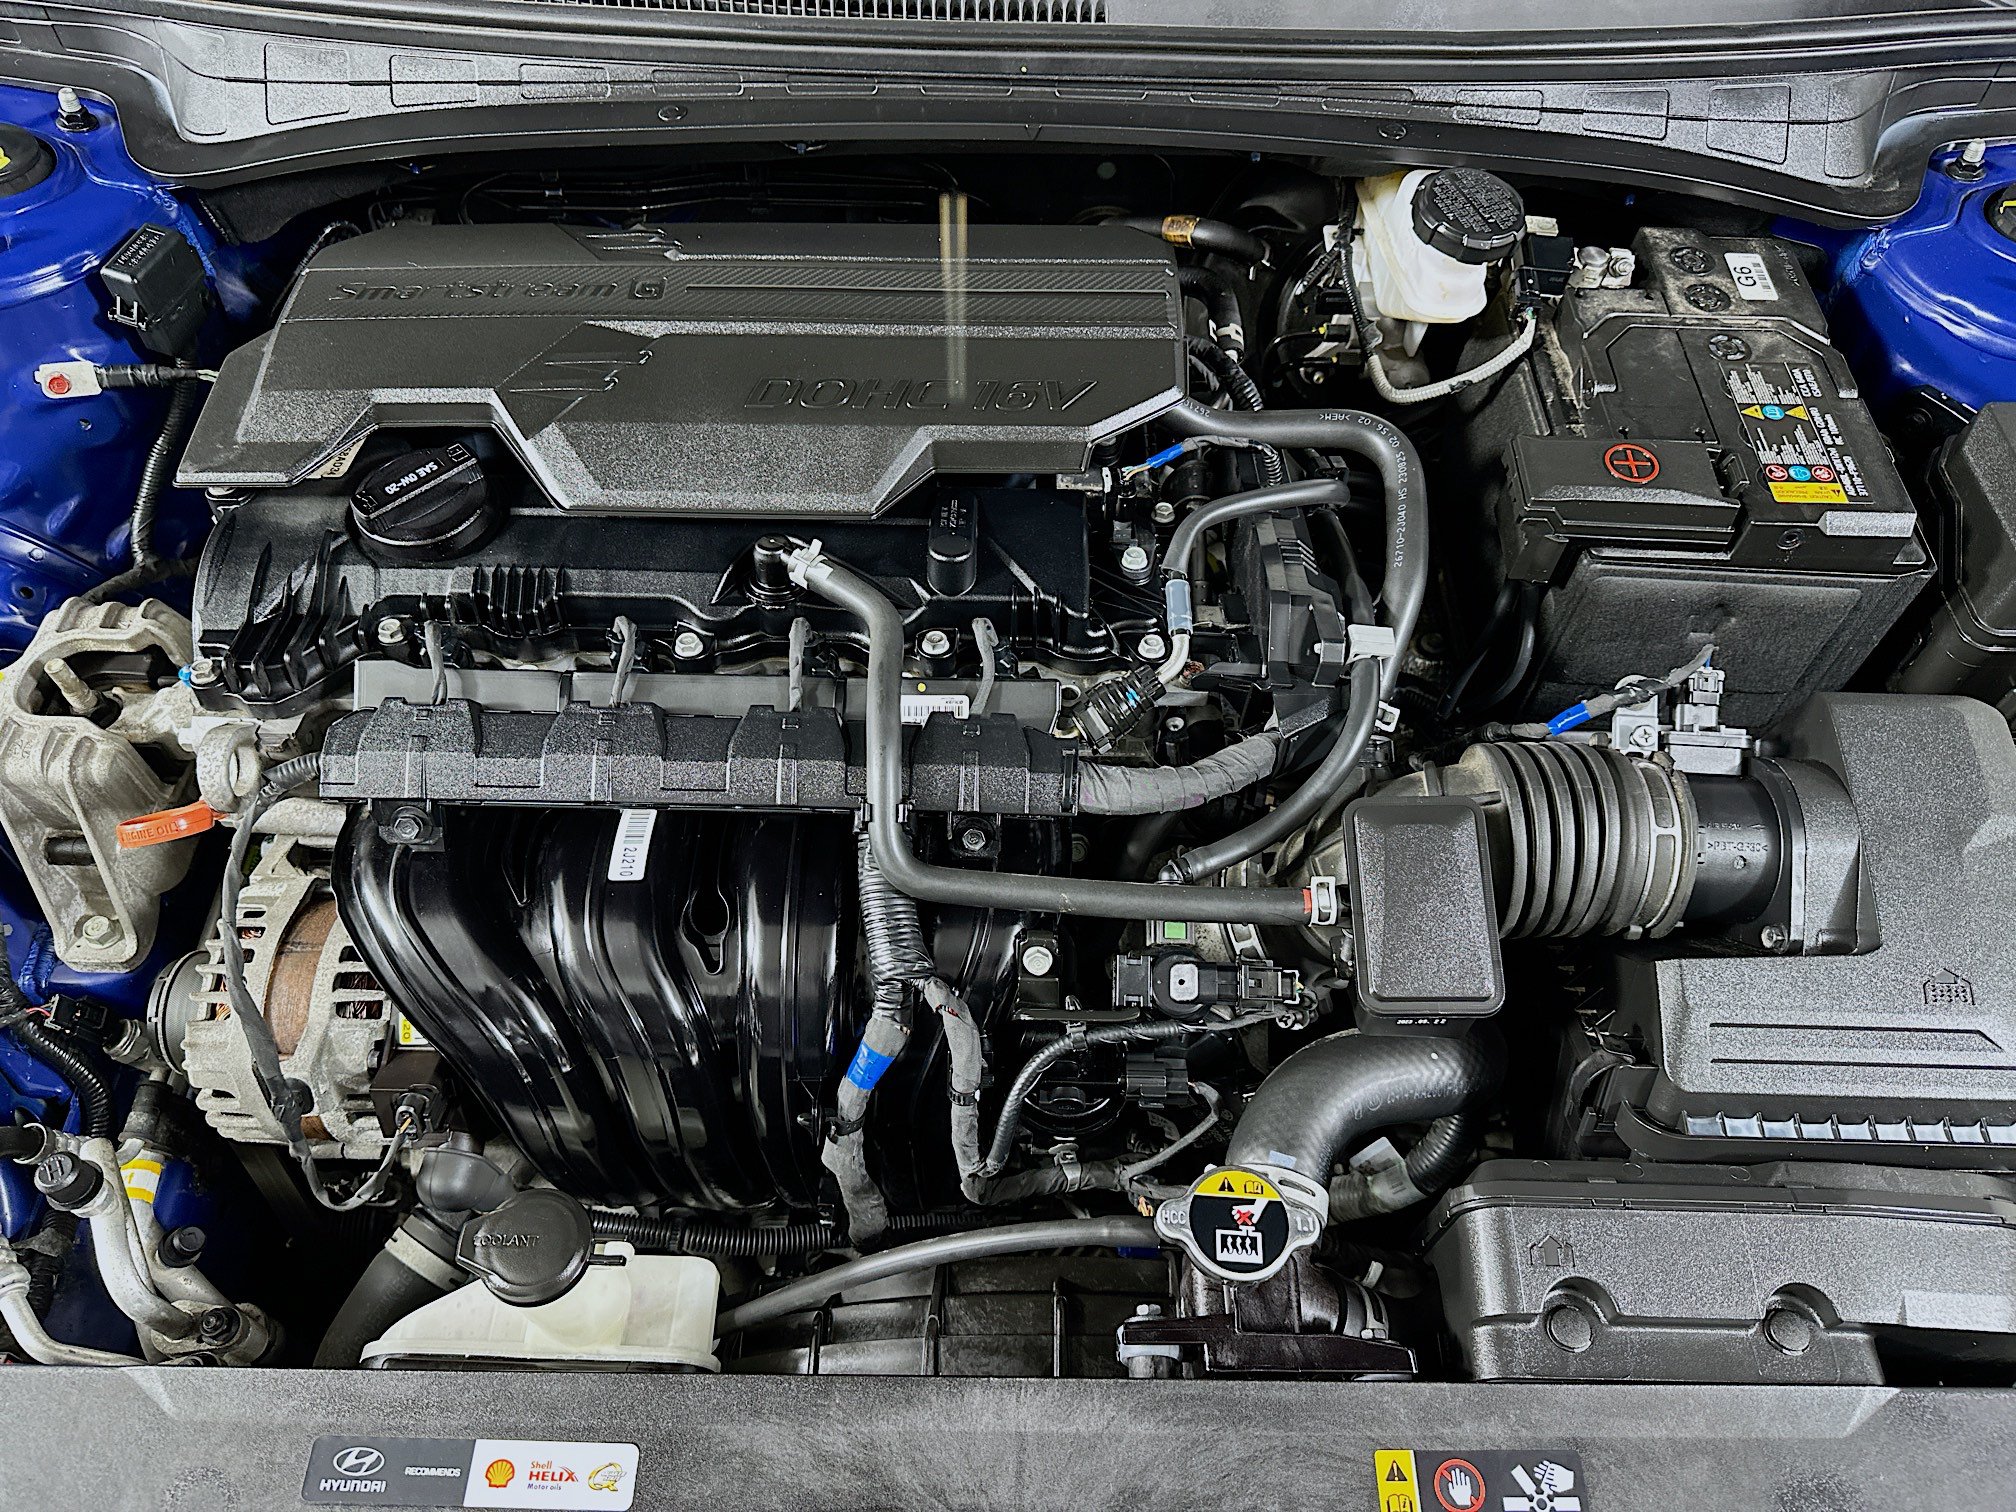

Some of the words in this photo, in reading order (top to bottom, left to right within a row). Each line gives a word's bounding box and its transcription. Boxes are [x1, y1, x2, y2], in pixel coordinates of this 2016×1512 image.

[1733, 265, 1757, 288] G6
[328, 279, 618, 301] Smartstream
[744, 378, 957, 410] DOHC
[972, 379, 1099, 411] 16V
[415, 461, 439, 478] SAE
[1395, 451, 1408, 484] 230825
[384, 473, 417, 495] 0W-20
[1397, 487, 1408, 501] HS
[1393, 504, 1407, 568] 26710-2J040
[619, 846, 638, 877] 2J210
[1161, 1209, 1187, 1226] HCC
[473, 1233, 540, 1247] COOLANT
[528, 1470, 577, 1482] HELIX
[530, 1460, 553, 1471] Shell
[318, 1478, 387, 1494] HYUNDAI
[404, 1465, 461, 1478] RECOMMENDS
[527, 1482, 549, 1491] Motor
[549, 1482, 562, 1491] oils
